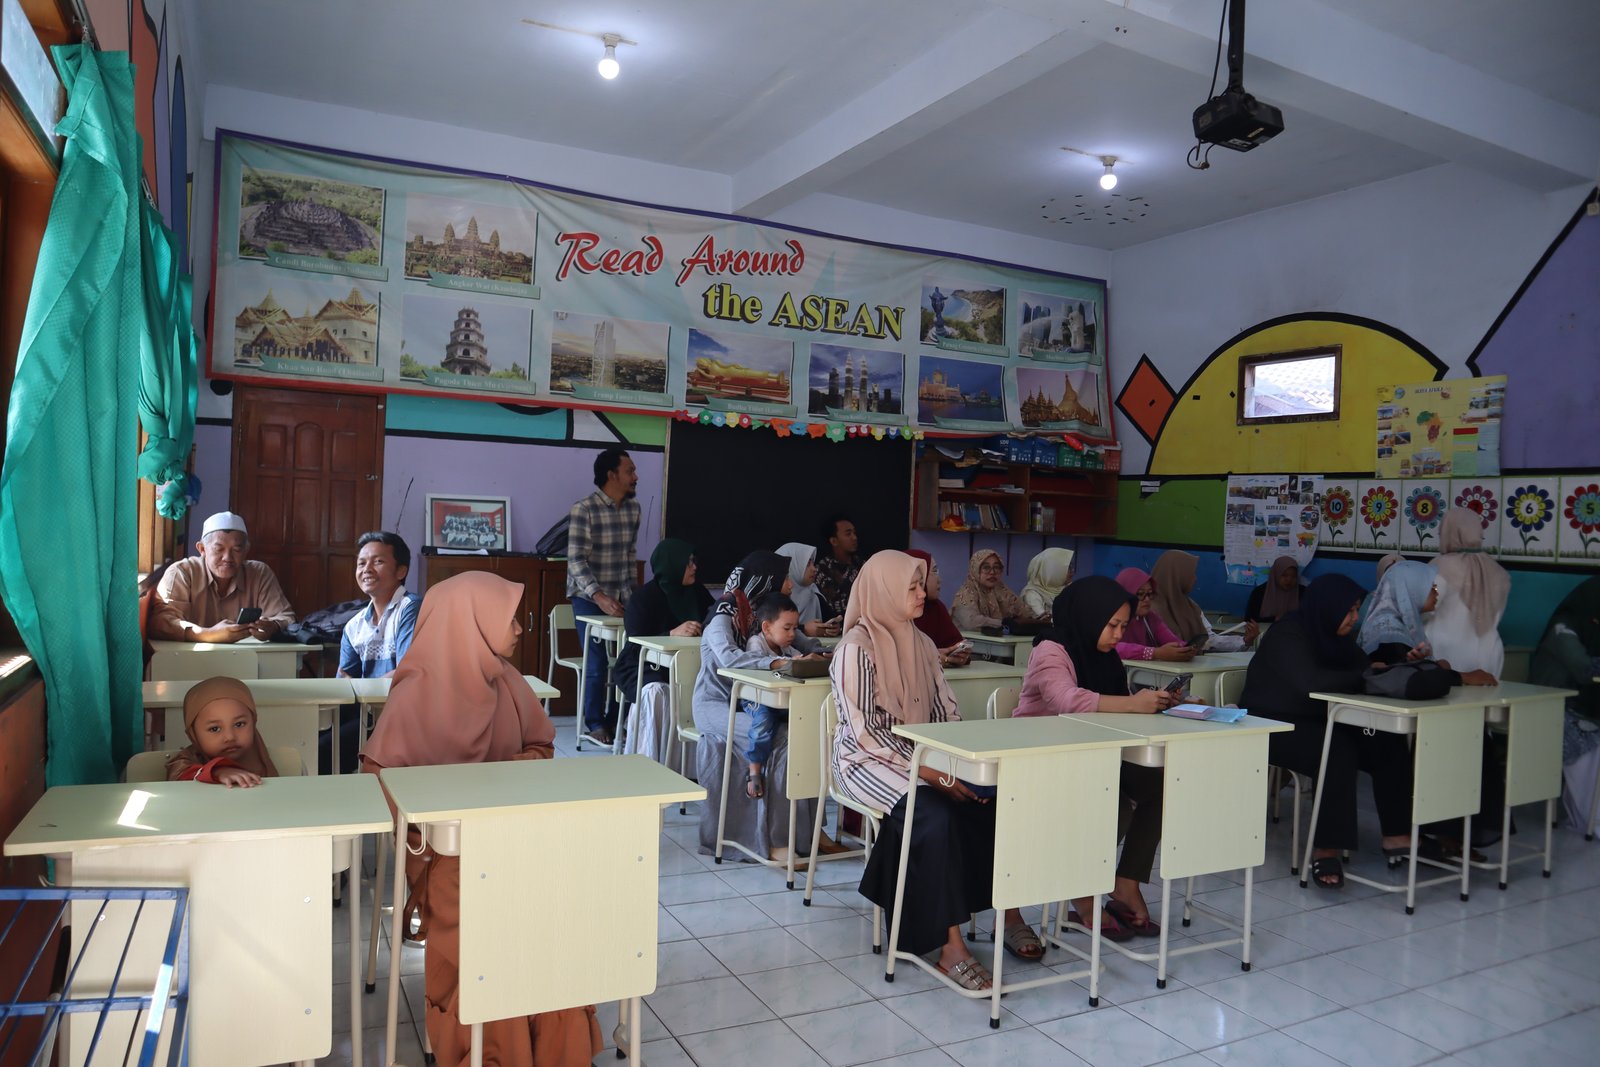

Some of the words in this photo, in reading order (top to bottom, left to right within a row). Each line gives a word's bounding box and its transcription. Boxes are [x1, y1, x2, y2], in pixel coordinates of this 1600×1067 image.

[555, 231, 664, 281] Read
[675, 234, 805, 287] Around
[702, 283, 762, 323] the
[768, 291, 905, 341] ASEAN
[1331, 501, 1342, 512] 10
[1375, 502, 1382, 512] 9
[1420, 502, 1429, 514] 8
[1525, 502, 1534, 514] 6
[1586, 502, 1595, 515] 5
